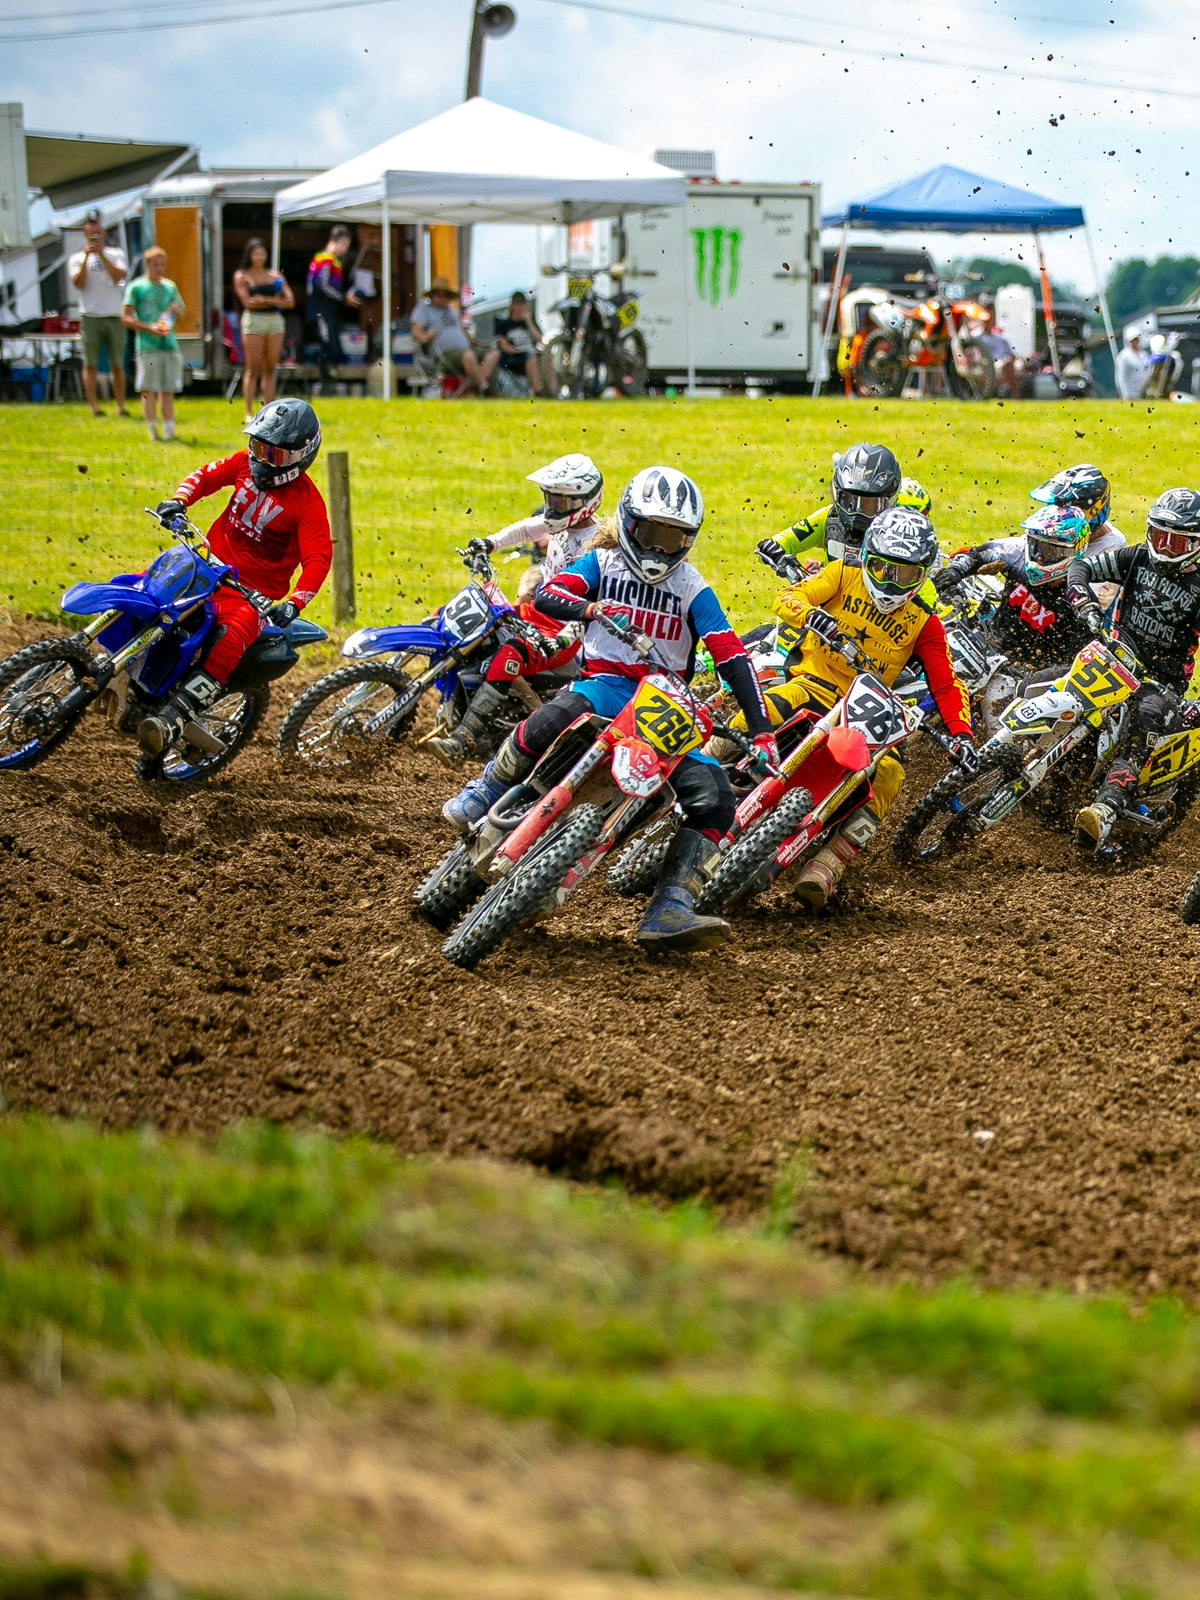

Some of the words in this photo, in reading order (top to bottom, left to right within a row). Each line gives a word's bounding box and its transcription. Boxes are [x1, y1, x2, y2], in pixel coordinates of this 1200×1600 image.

[1010, 585, 1050, 627] FOX
[1136, 567, 1197, 612] FASTHOUSE
[446, 595, 486, 638] 94
[842, 594, 909, 645] ASTHOUSE
[1130, 605, 1176, 641] CUSTOMS
[1072, 659, 1125, 699] 57
[634, 694, 696, 753] 269
[847, 692, 903, 743] 98
[1149, 735, 1192, 780] 57
